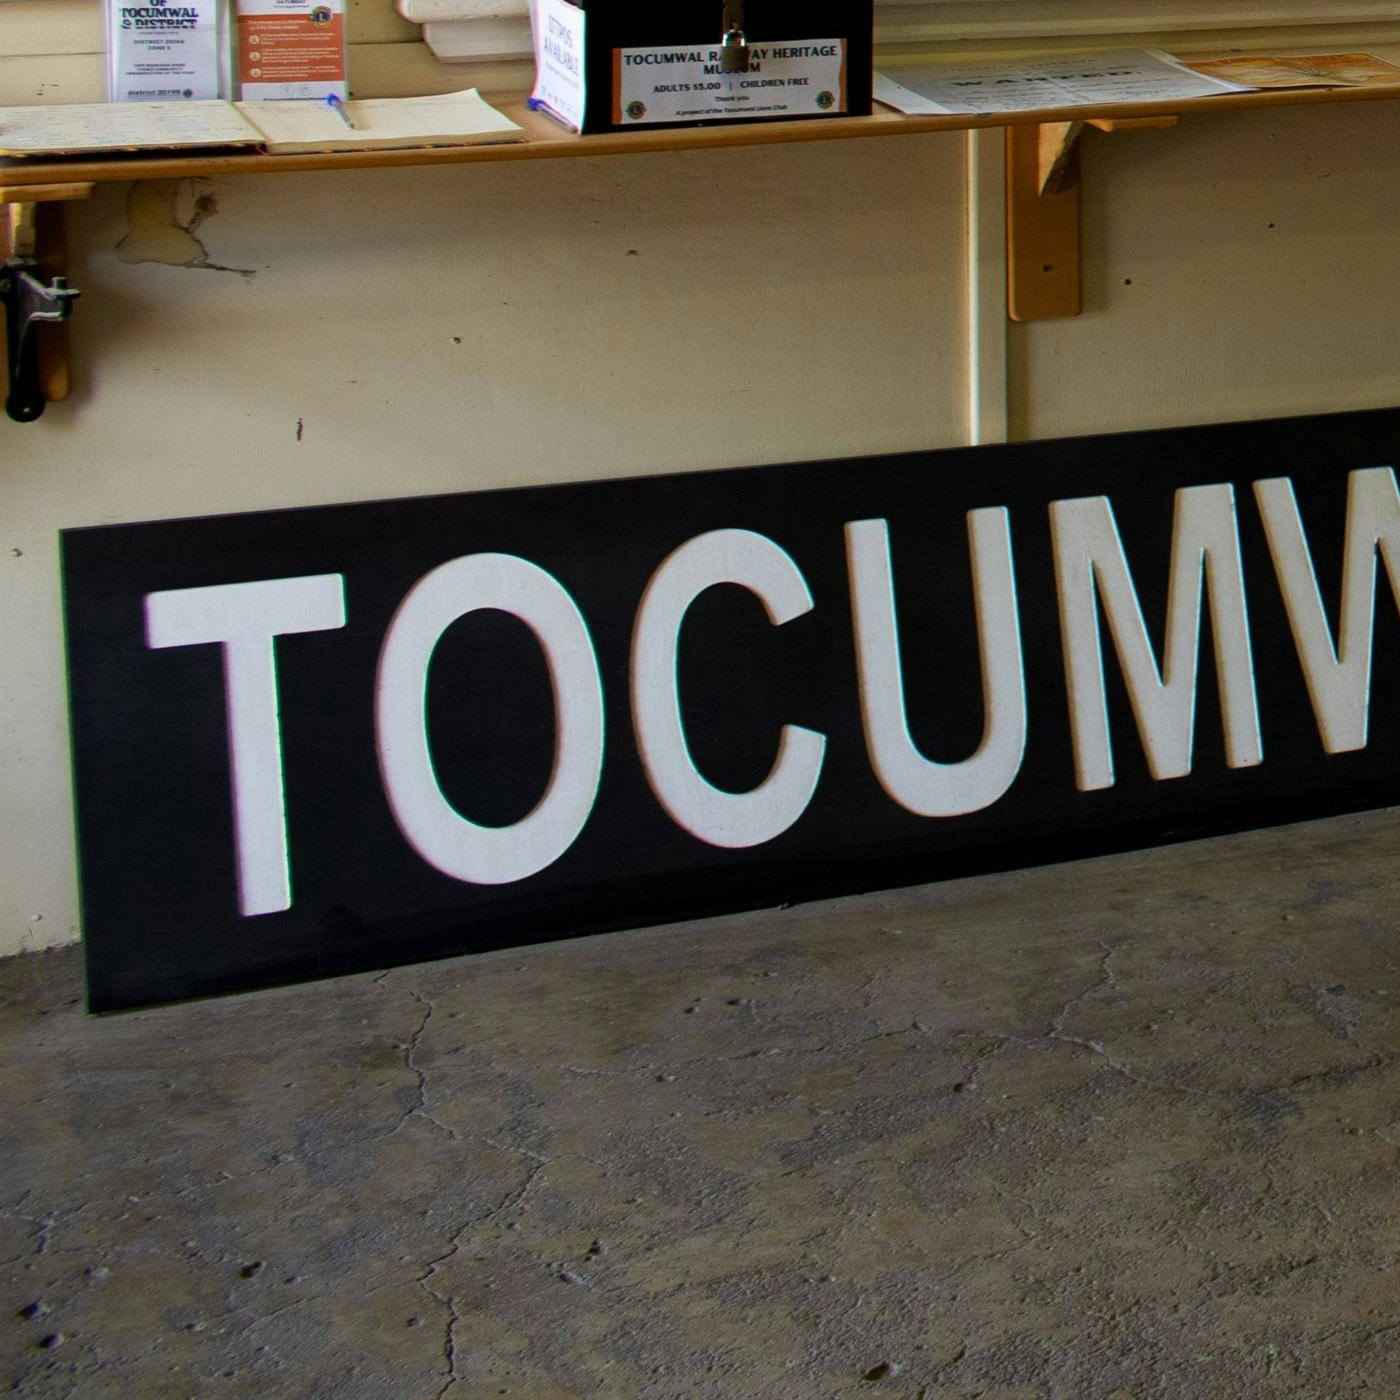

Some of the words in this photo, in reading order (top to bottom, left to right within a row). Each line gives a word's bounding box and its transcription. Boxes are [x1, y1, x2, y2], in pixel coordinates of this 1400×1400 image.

[122, 7, 199, 18] TOCUMWAL
[544, 35, 579, 76] AVAILABLE
[624, 51, 704, 66] TOCUMWAL
[772, 46, 838, 59] HERITAGE
[653, 82, 690, 93] ADULTS
[693, 82, 721, 91] $5.00
[740, 79, 785, 89] CHILDREN
[787, 77, 810, 87] FREE
[950, 70, 1134, 88] WANTED
